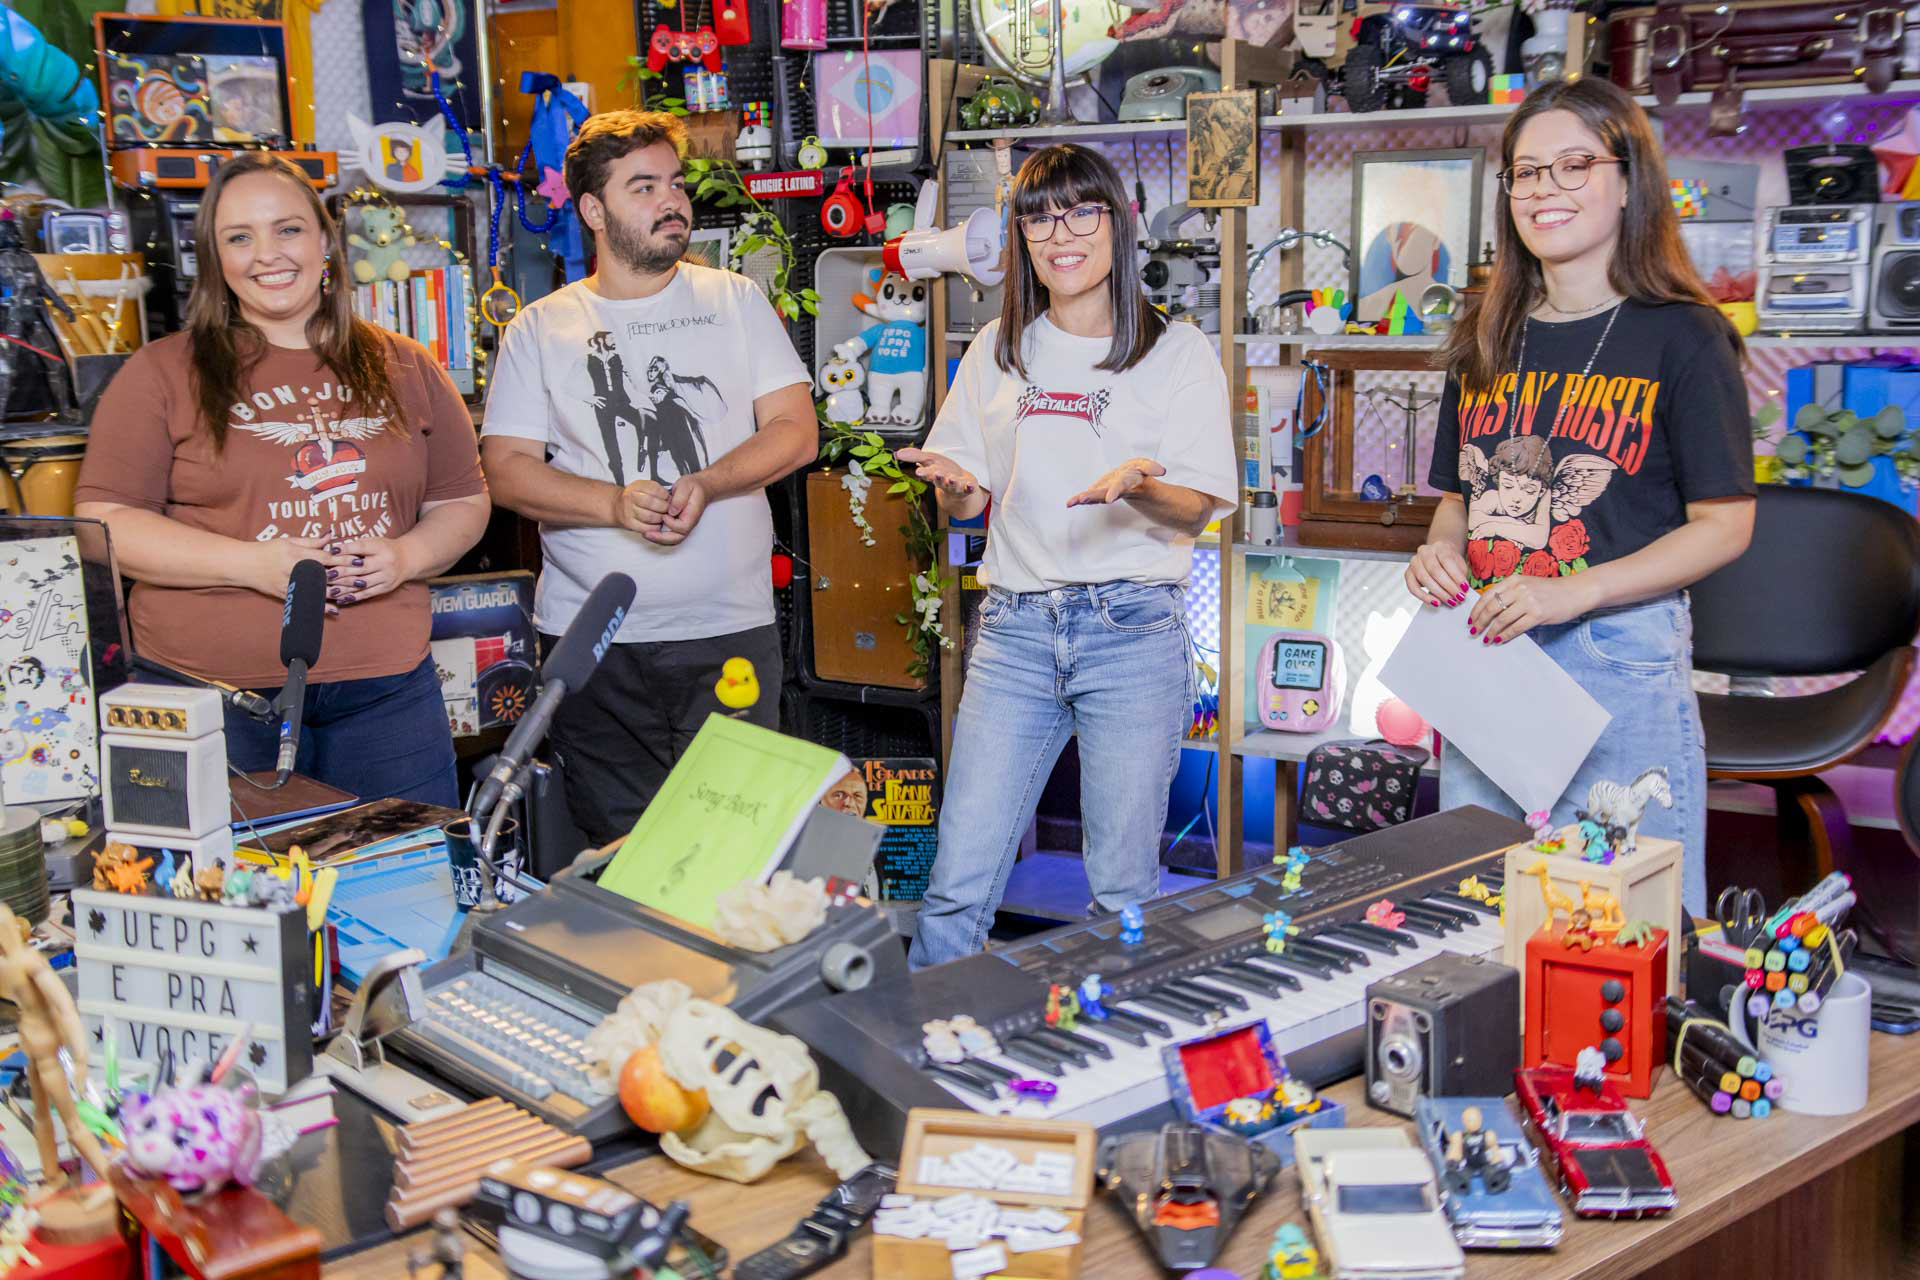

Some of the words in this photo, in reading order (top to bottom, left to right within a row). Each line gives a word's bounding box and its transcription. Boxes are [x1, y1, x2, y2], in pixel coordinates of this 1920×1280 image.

[750, 178, 783, 194] SANGUE
[785, 176, 815, 192] LATINO
[229, 384, 297, 422] BON
[1551, 373, 1660, 476] ROSES
[268, 500, 320, 520] YOUR
[351, 491, 388, 513] LOVE
[301, 521, 322, 538] IS
[330, 515, 366, 540] LIKE
[465, 589, 519, 611] GUARDA
[1284, 648, 1318, 660] GAME
[885, 779, 932, 805] FRANK
[865, 798, 937, 825] SINATRA
[122, 909, 216, 957] UEPG
[112, 964, 127, 1002] E
[168, 973, 236, 1017] PRA
[129, 1021, 222, 1065] VOCE
